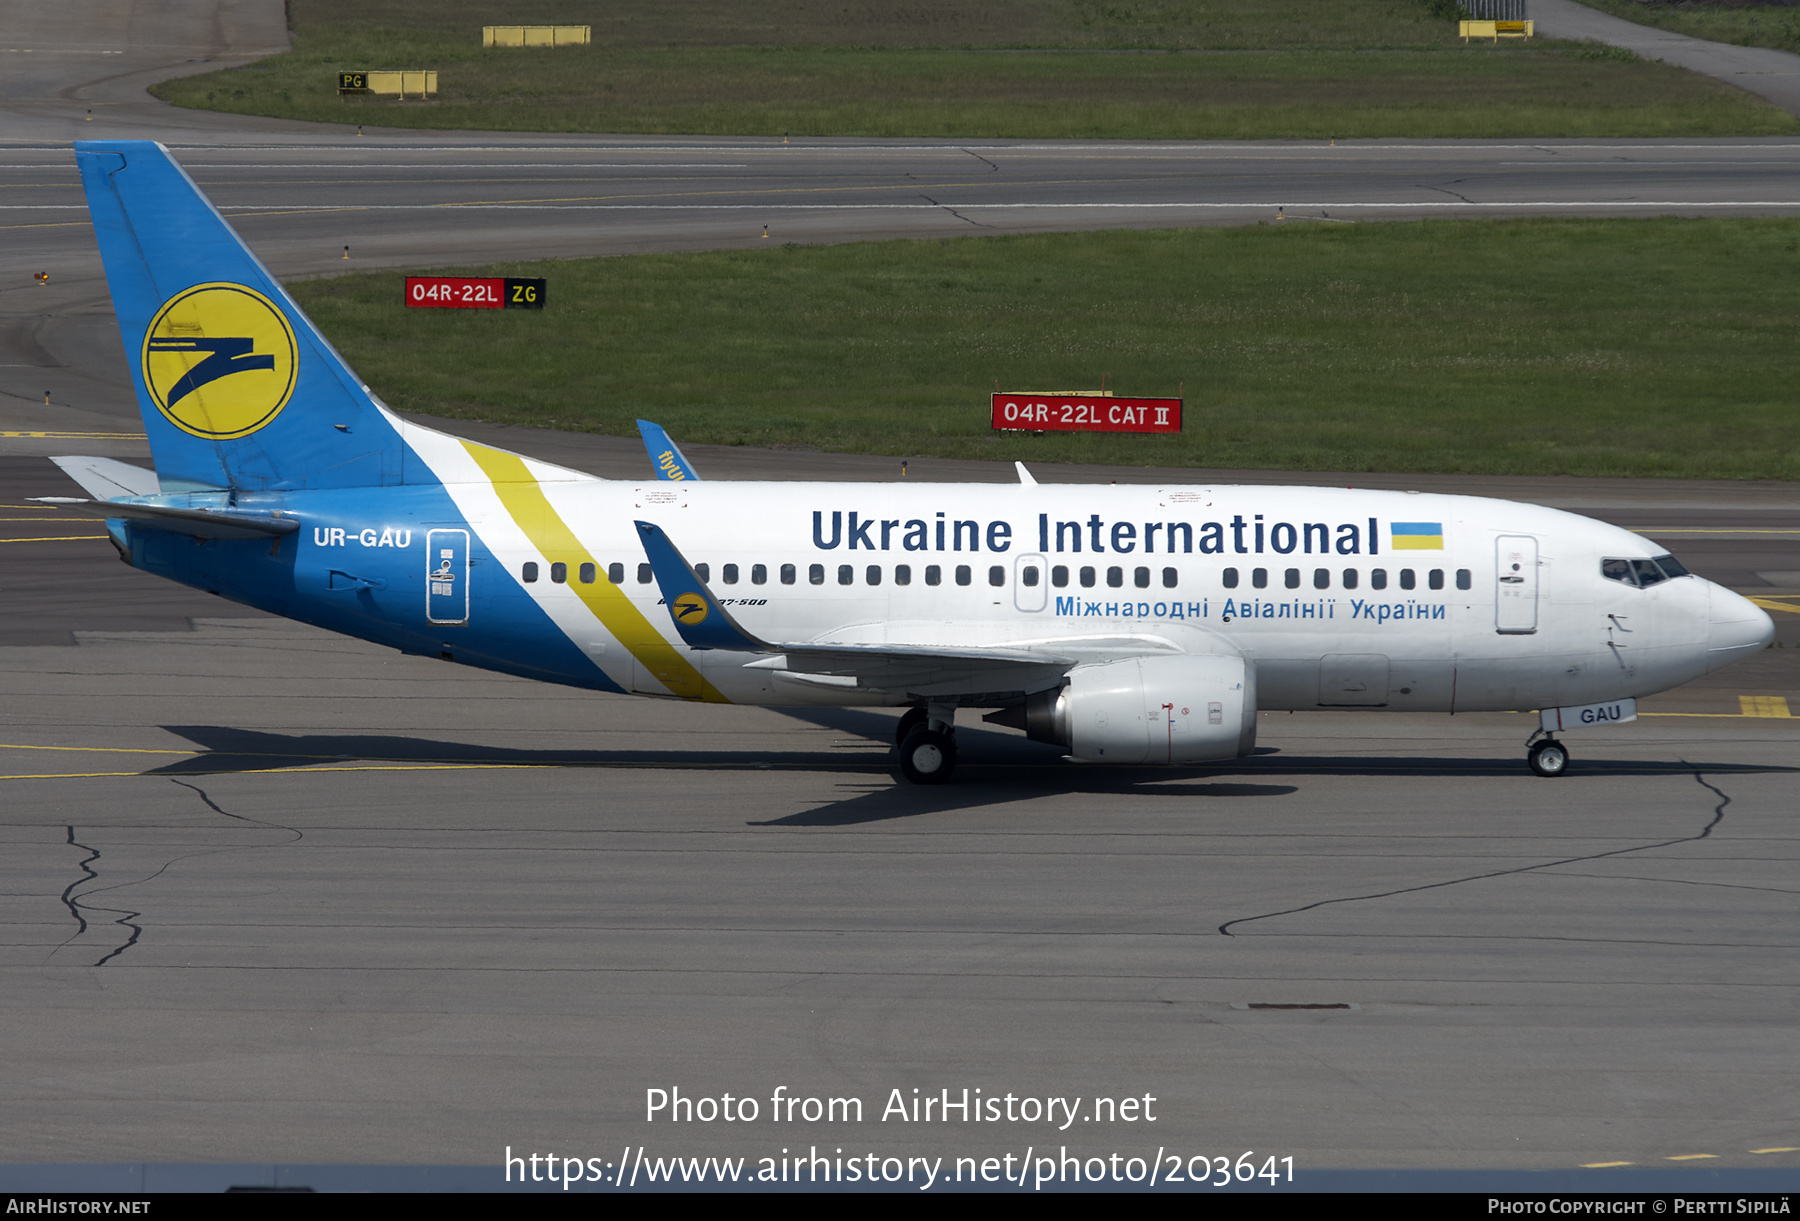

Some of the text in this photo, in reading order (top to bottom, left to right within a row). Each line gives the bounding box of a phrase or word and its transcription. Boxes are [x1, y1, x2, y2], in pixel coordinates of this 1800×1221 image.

[344, 75, 361, 87] PG
[412, 284, 536, 302] 04R-22L ZG
[1004, 403, 1101, 423] 04R-22L
[1108, 406, 1148, 424] CAT
[314, 527, 412, 549] UR-GAU
[813, 511, 1378, 555] Ukraine International
[1055, 596, 1445, 625] Міжнародні Авіалінії України
[1581, 705, 1621, 723] GAU
